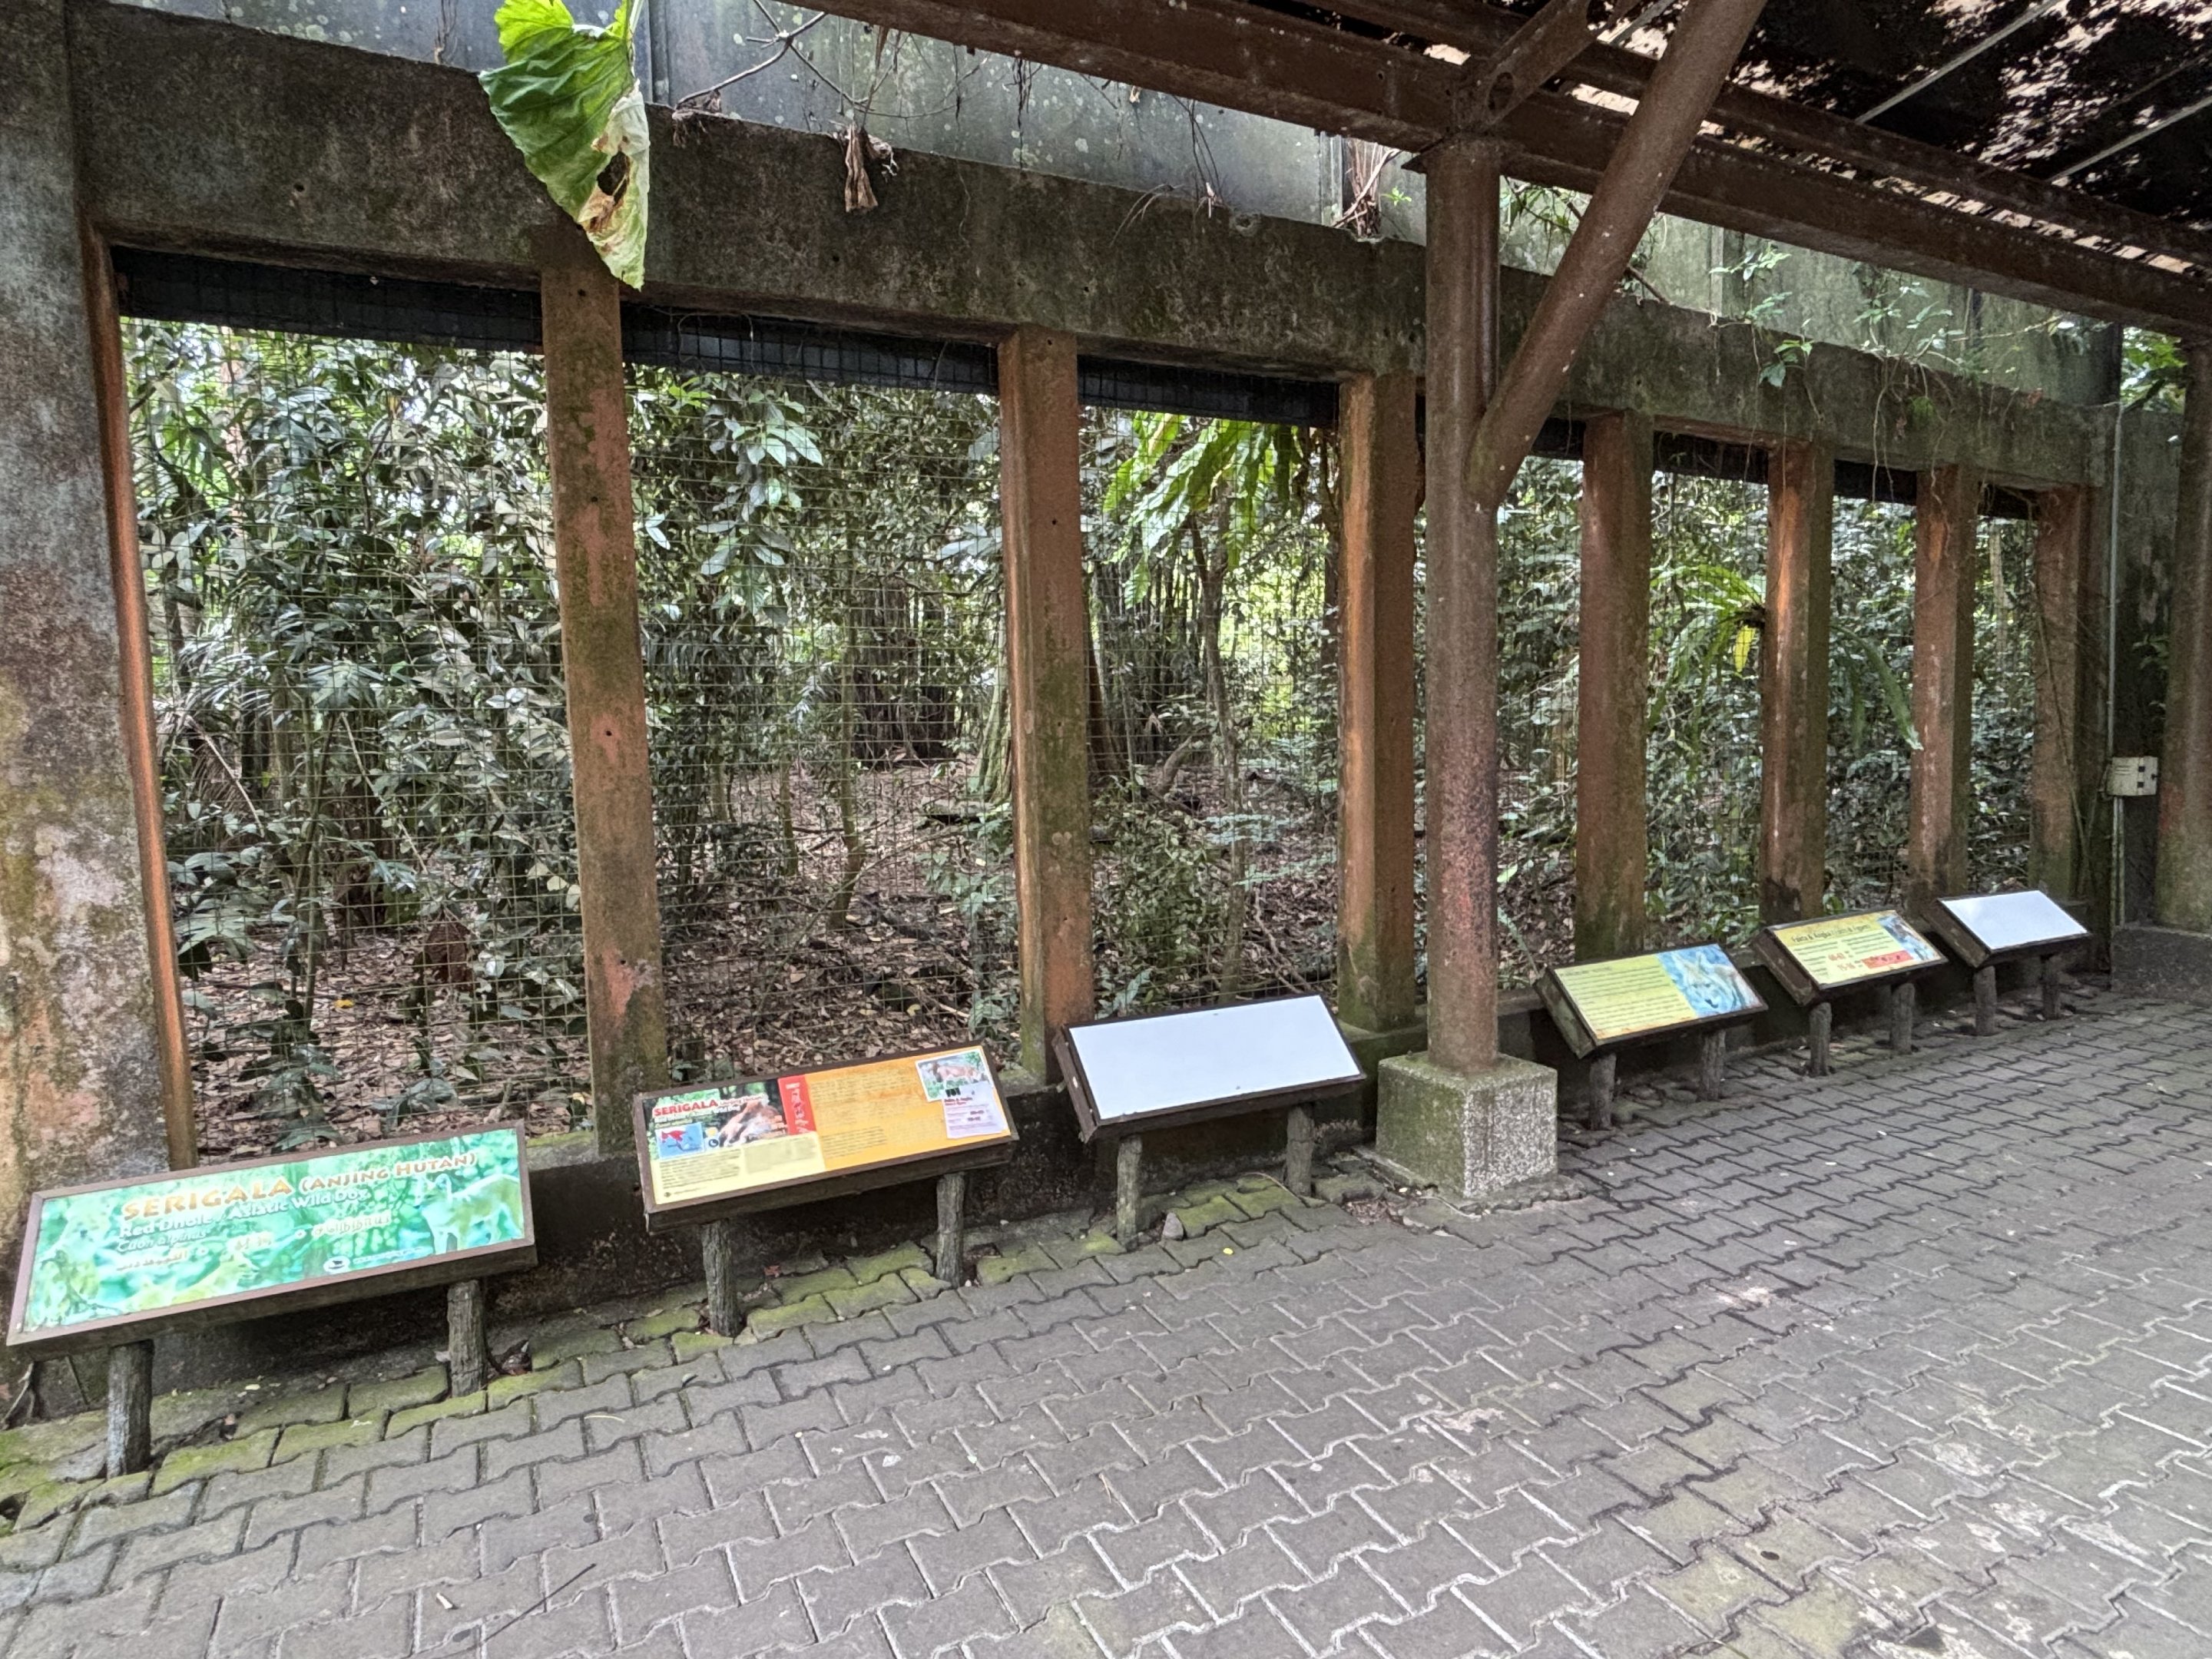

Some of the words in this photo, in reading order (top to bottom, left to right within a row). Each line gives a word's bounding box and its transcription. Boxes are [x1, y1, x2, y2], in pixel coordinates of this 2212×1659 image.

[654, 1099, 719, 1117] SERIGALA
[124, 1179, 293, 1221] SERIGALA
[301, 1170, 389, 1192] (ANJING
[396, 1152, 476, 1177] HUTAN)
[120, 1220, 155, 1240] Red
[292, 1192, 332, 1209] Wild
